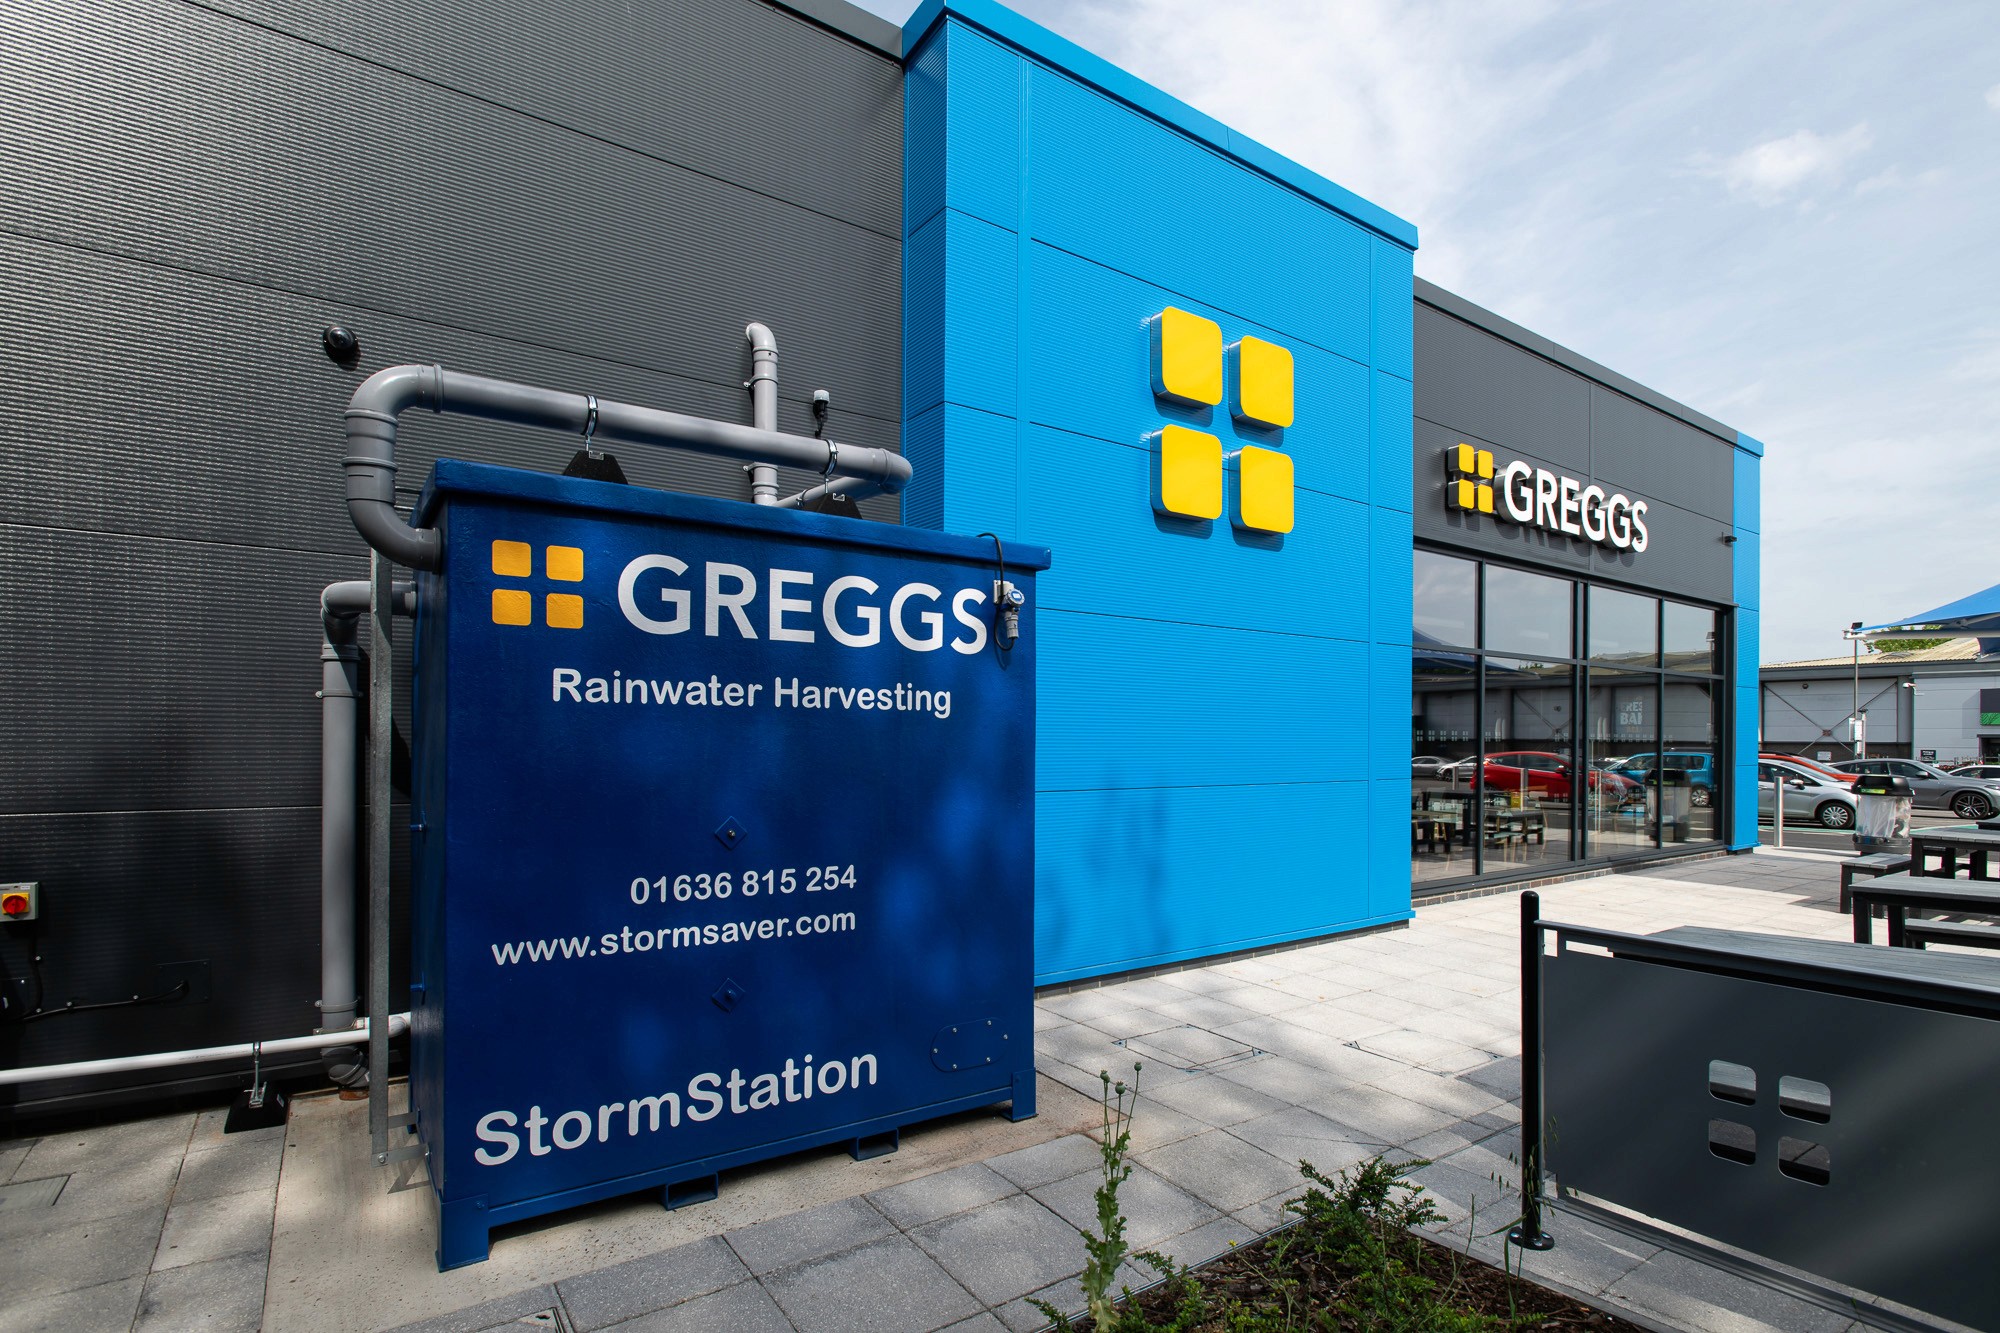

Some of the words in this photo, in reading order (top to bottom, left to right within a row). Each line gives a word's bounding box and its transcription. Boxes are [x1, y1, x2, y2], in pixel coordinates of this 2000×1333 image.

[1501, 460, 1648, 553] GREGGS
[617, 553, 988, 655] GREGGS
[552, 667, 763, 708] Rainwater
[774, 676, 952, 719] Harvesting
[630, 872, 732, 905] 01636
[741, 868, 797, 897] 815
[805, 864, 857, 892] 254
[491, 912, 857, 966] www.stormsaver.com
[474, 1053, 877, 1166] StormStation
